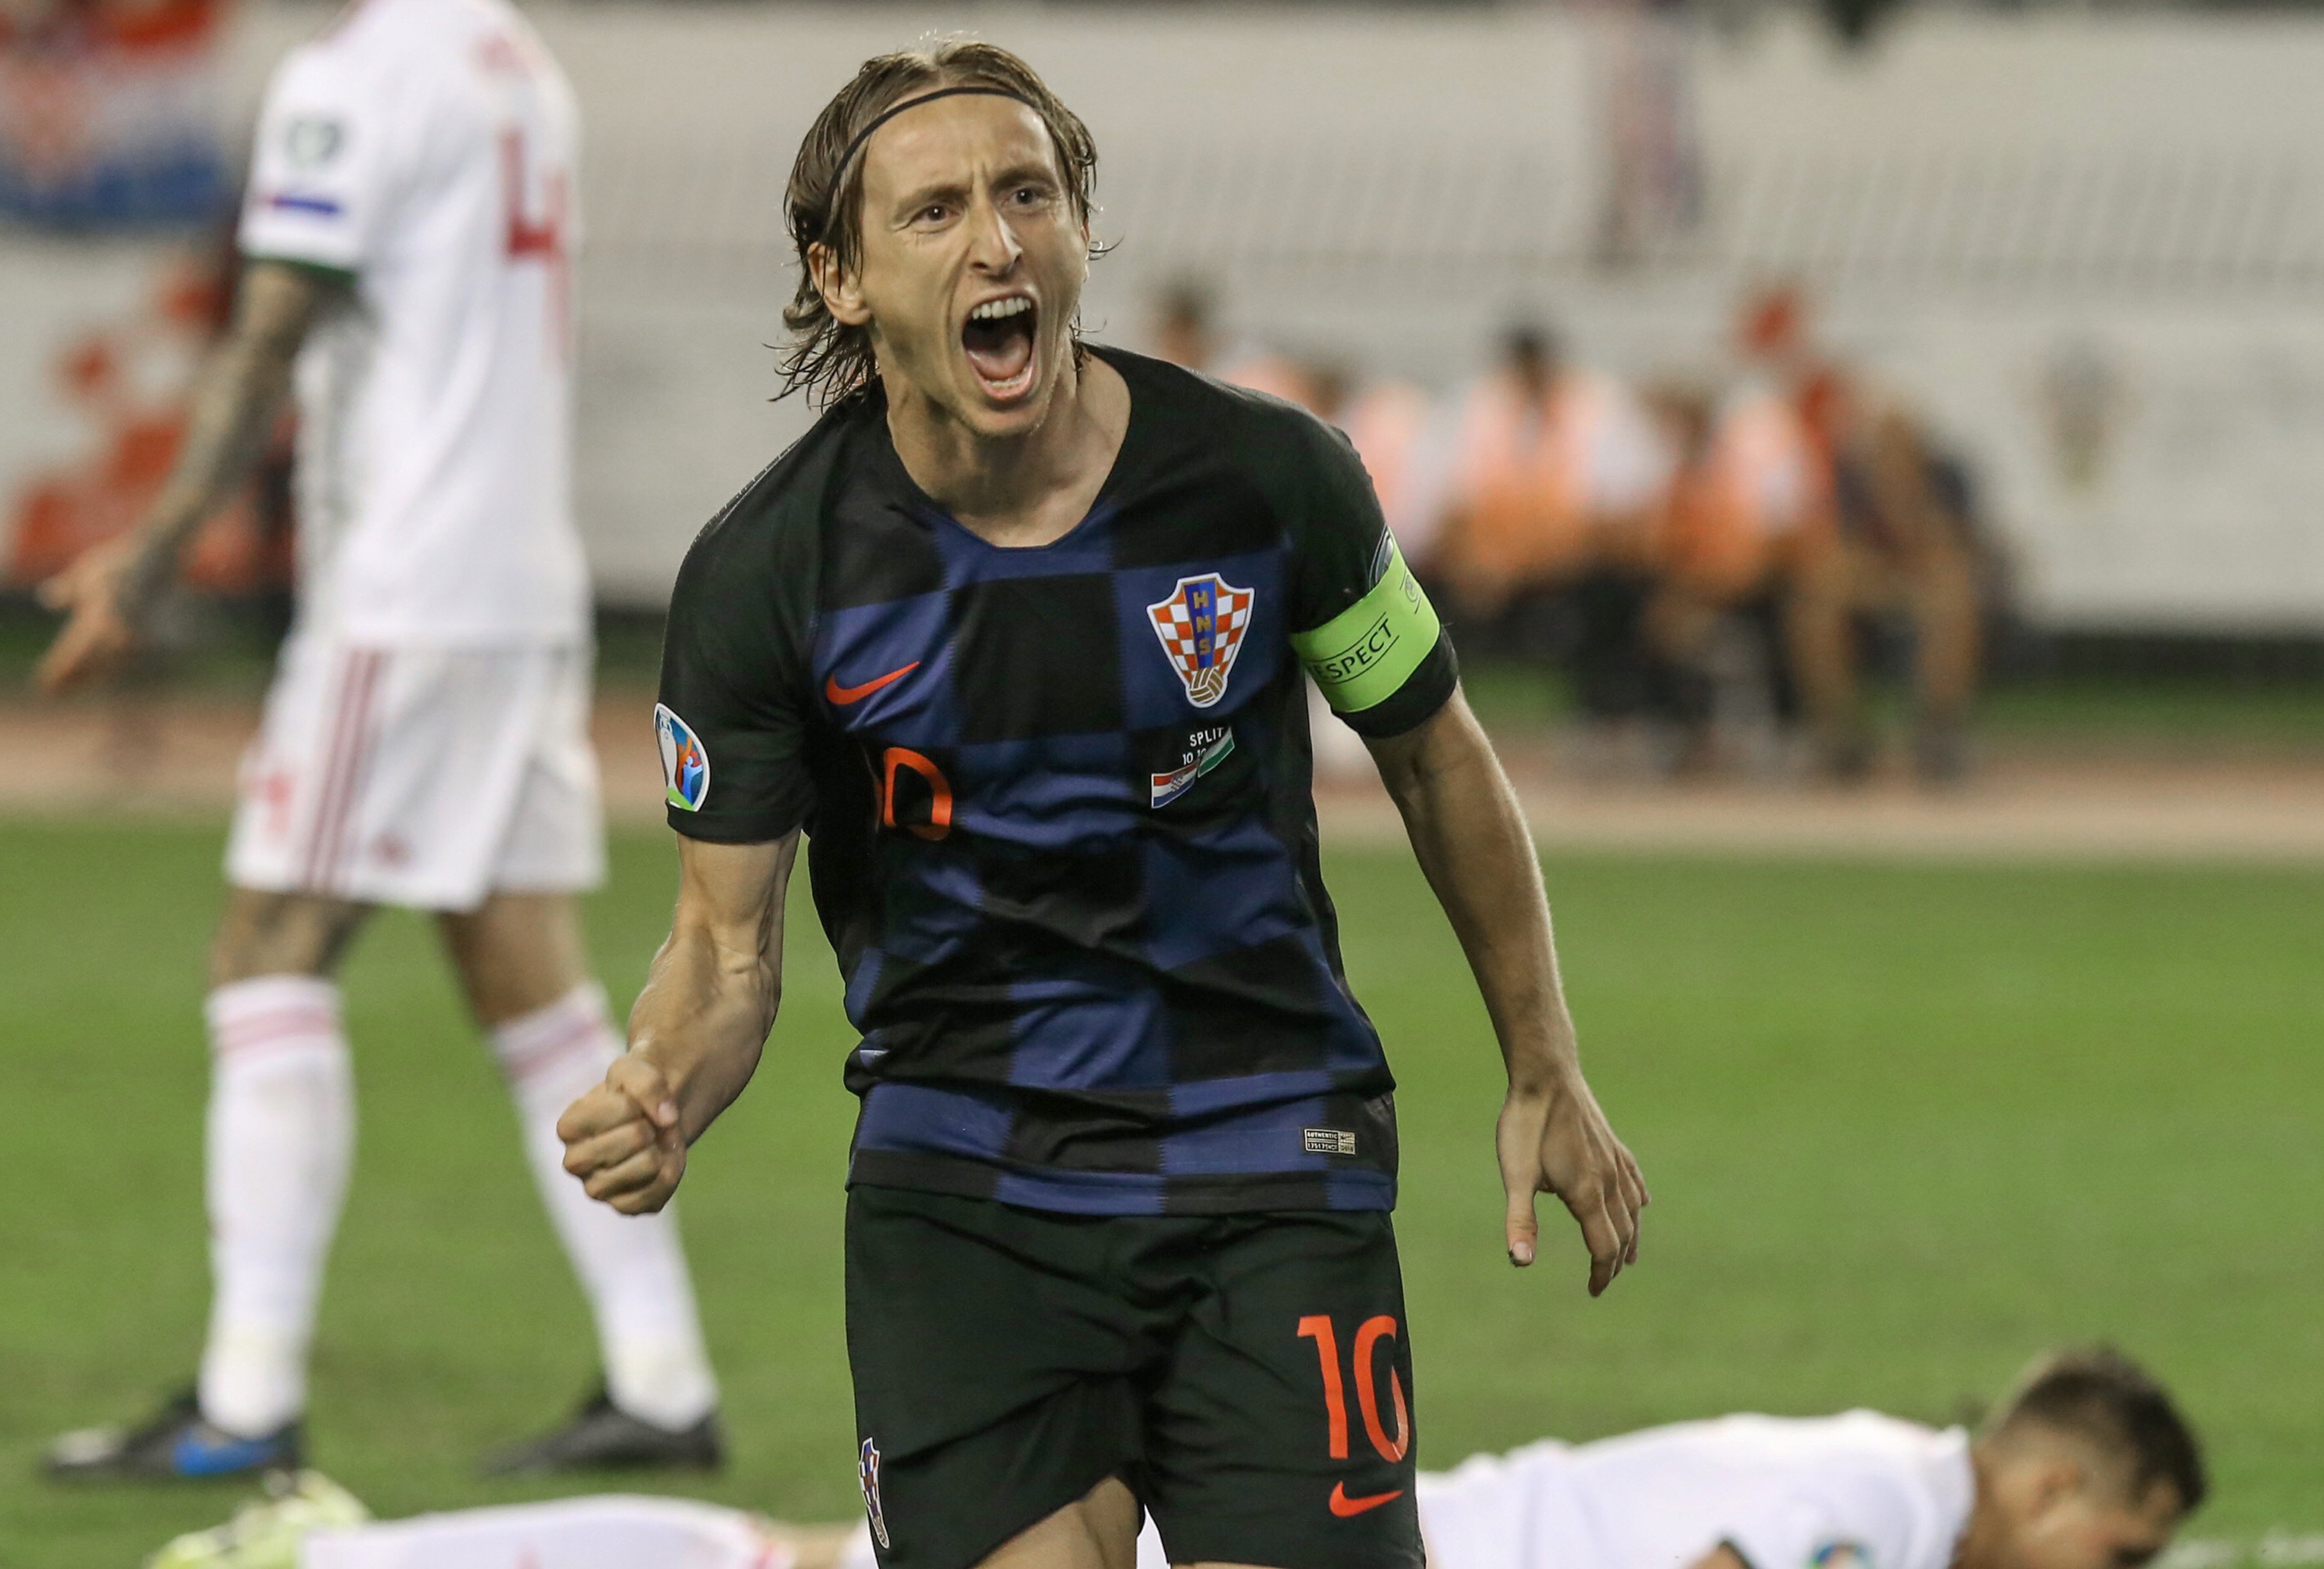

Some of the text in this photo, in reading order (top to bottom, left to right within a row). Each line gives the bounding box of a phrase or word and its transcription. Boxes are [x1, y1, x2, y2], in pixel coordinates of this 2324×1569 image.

[1193, 589, 1212, 655] HNS
[1182, 752, 1194, 765] 10
[1189, 727, 1224, 747] SPLIT
[1297, 1314, 1410, 1463] 10
